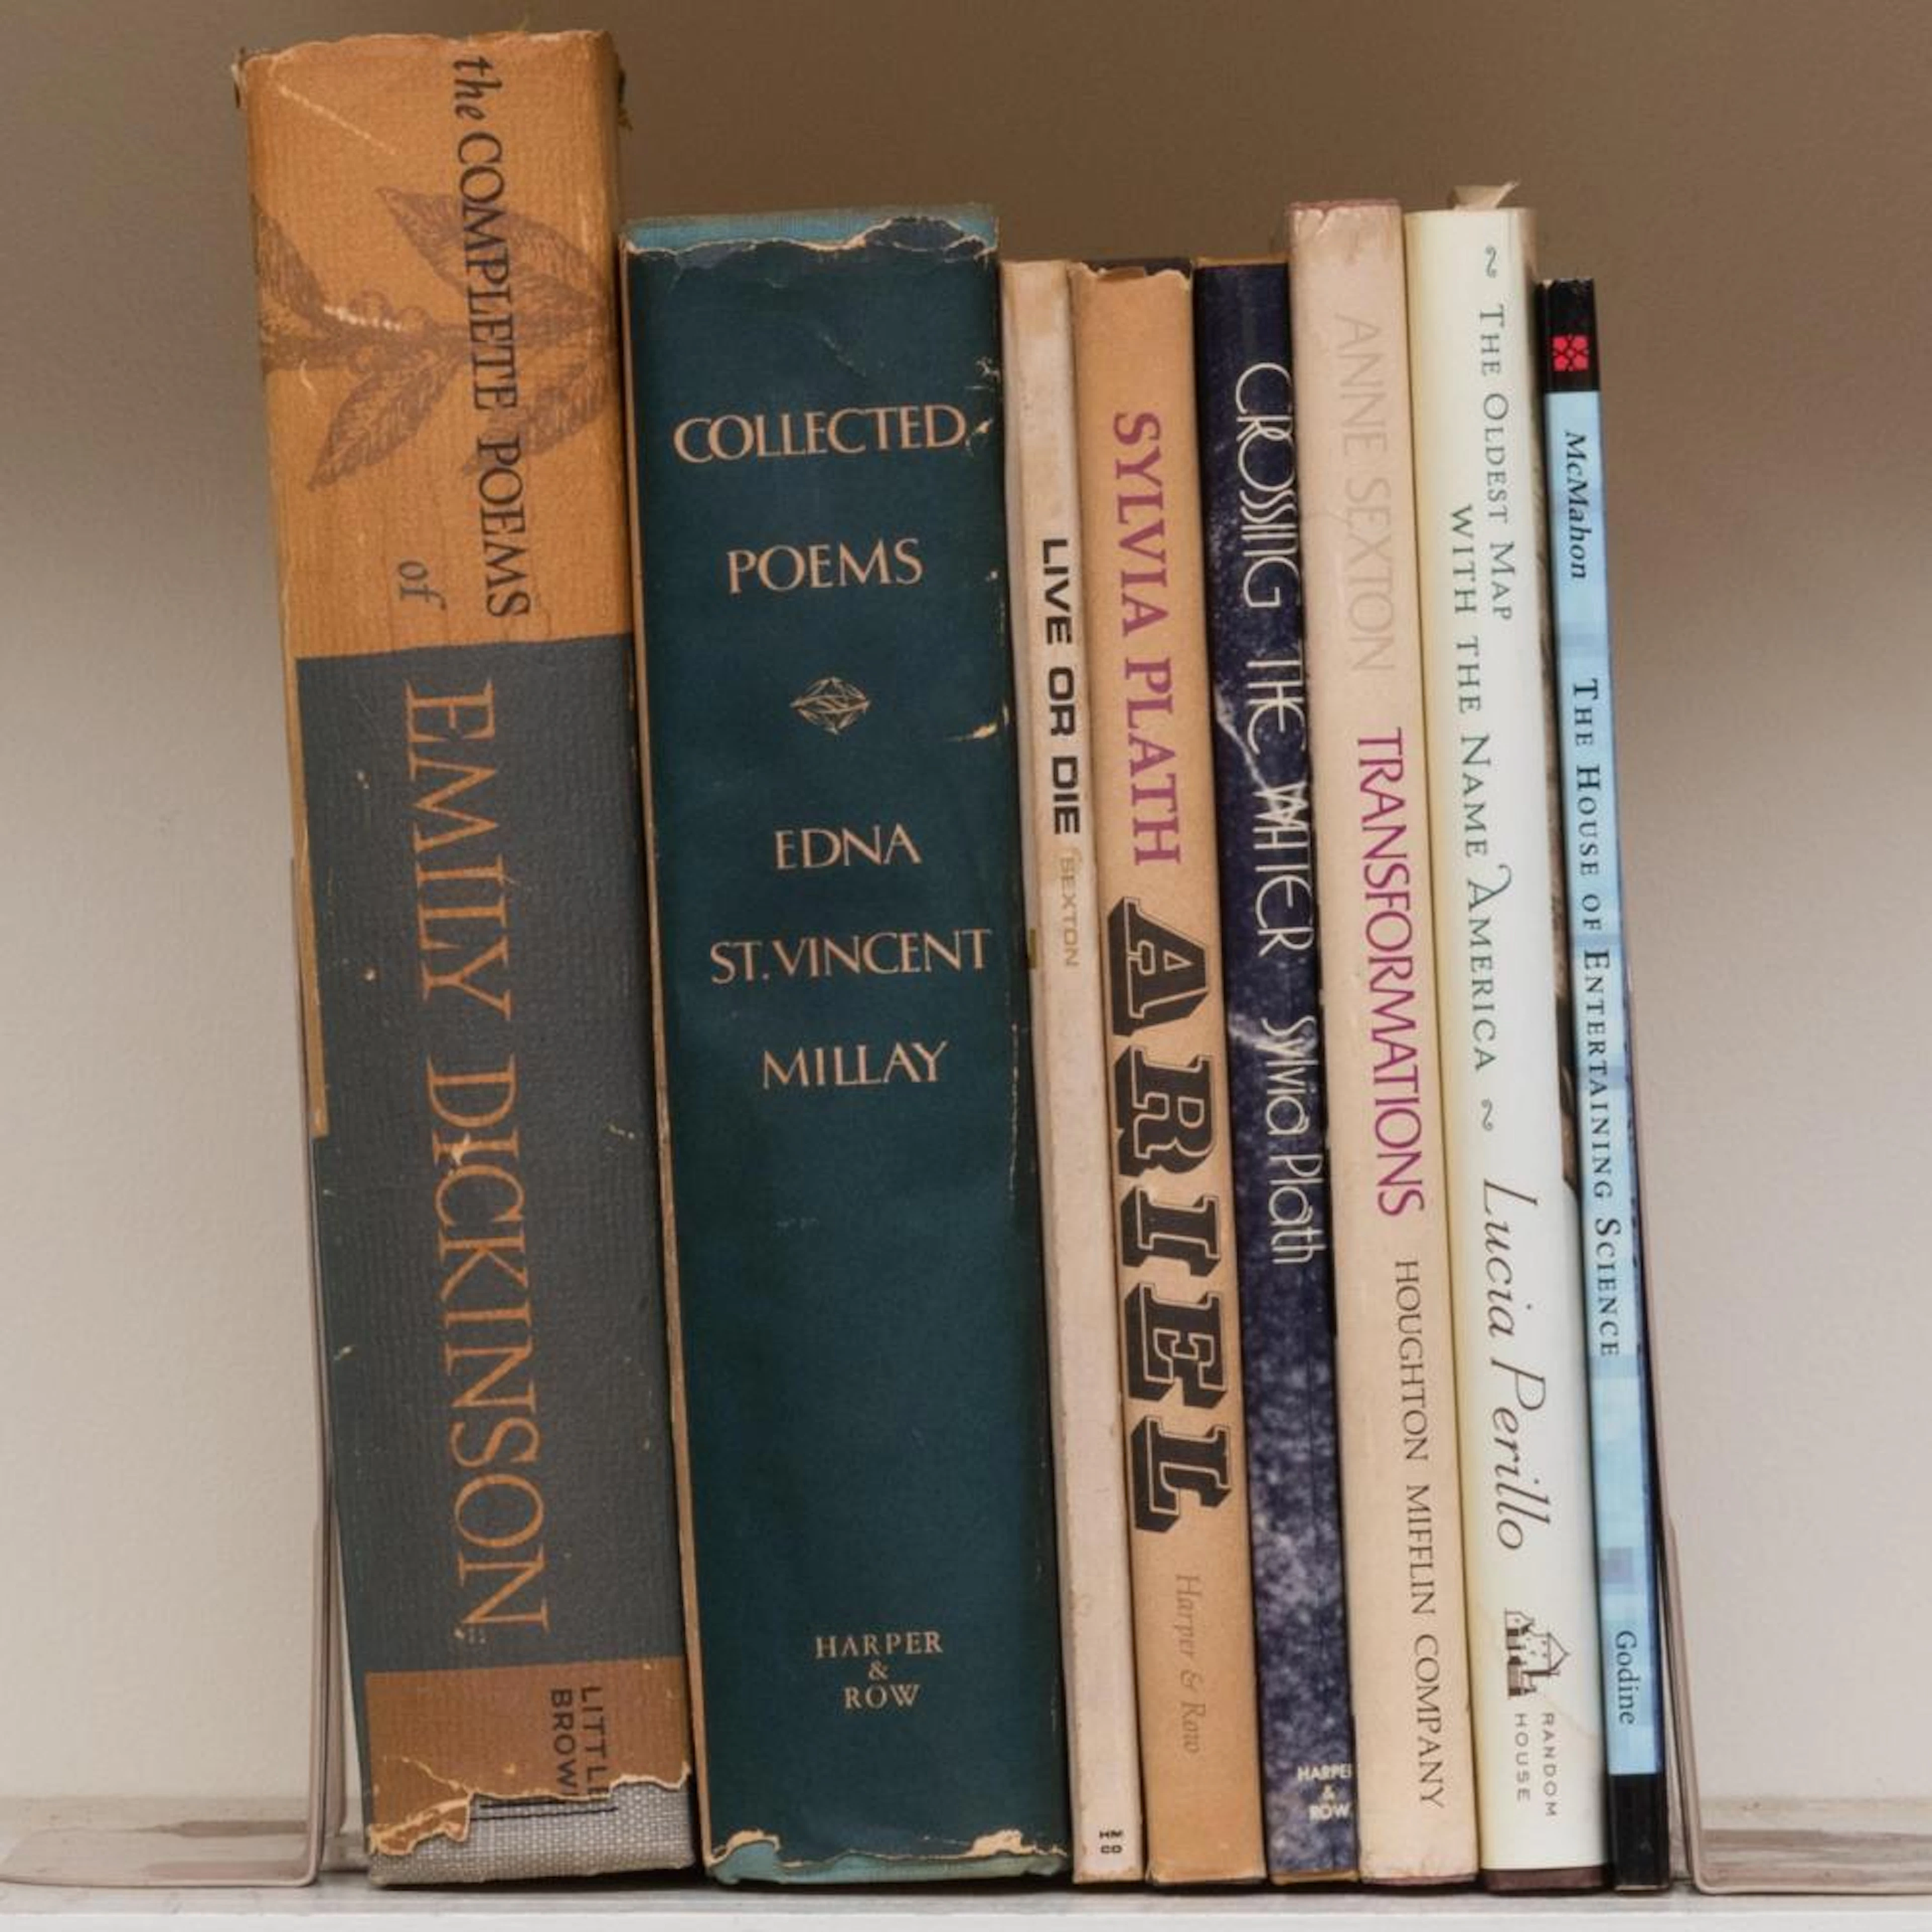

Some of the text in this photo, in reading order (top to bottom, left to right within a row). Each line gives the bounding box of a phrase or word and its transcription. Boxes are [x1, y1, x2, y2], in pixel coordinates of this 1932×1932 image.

[454, 55, 532, 619] the COMPLETE POEMS
[673, 404, 967, 463] COLLECTED
[1236, 362, 1301, 608] CROSSING
[1335, 313, 1396, 673] ANNE SEXTON
[1480, 304, 1515, 620] THE OLDEST MAP
[727, 538, 923, 594] POEMS
[1565, 430, 1592, 579] McMahon
[396, 560, 445, 610] of
[1112, 412, 1181, 866] SYLVIA PLATH
[1042, 538, 1080, 835] LIVE OR DIE
[1246, 641, 1306, 755] THE
[774, 823, 922, 870] EDNA
[1451, 504, 1512, 1072] WITH THE NAME AMERICA
[1060, 857, 1080, 967] SEXTON
[1357, 728, 1424, 1217] TRANSFORMATIONS
[763, 1040, 947, 1089] MILLAY
[1574, 679, 1621, 1357] THE HOUSE OF ENTERTAINING SCIENCE
[405, 680, 551, 1633] EMILY DICKINSON
[1255, 1015, 1327, 1266] Sylvia Plath
[1108, 896, 1231, 1533] ARIEL
[1483, 1179, 1551, 1551] Lucia Perillo
[1395, 1261, 1444, 1808] HOUGHTON MIFFLIN COMPANY
[816, 1631, 943, 1659] HARPER
[844, 1684, 920, 1709] ROW
[868, 1660, 889, 1680] &
[1174, 1575, 1206, 1753] Harper & Row
[1616, 1630, 1640, 1725] Godine
[550, 1688, 579, 1796] BROW
[1298, 1763, 1352, 1782] HARPE
[1514, 1713, 1530, 1801] HOUSE
[1542, 1713, 1557, 1816] RANDOM
[1309, 1802, 1352, 1821] ROW
